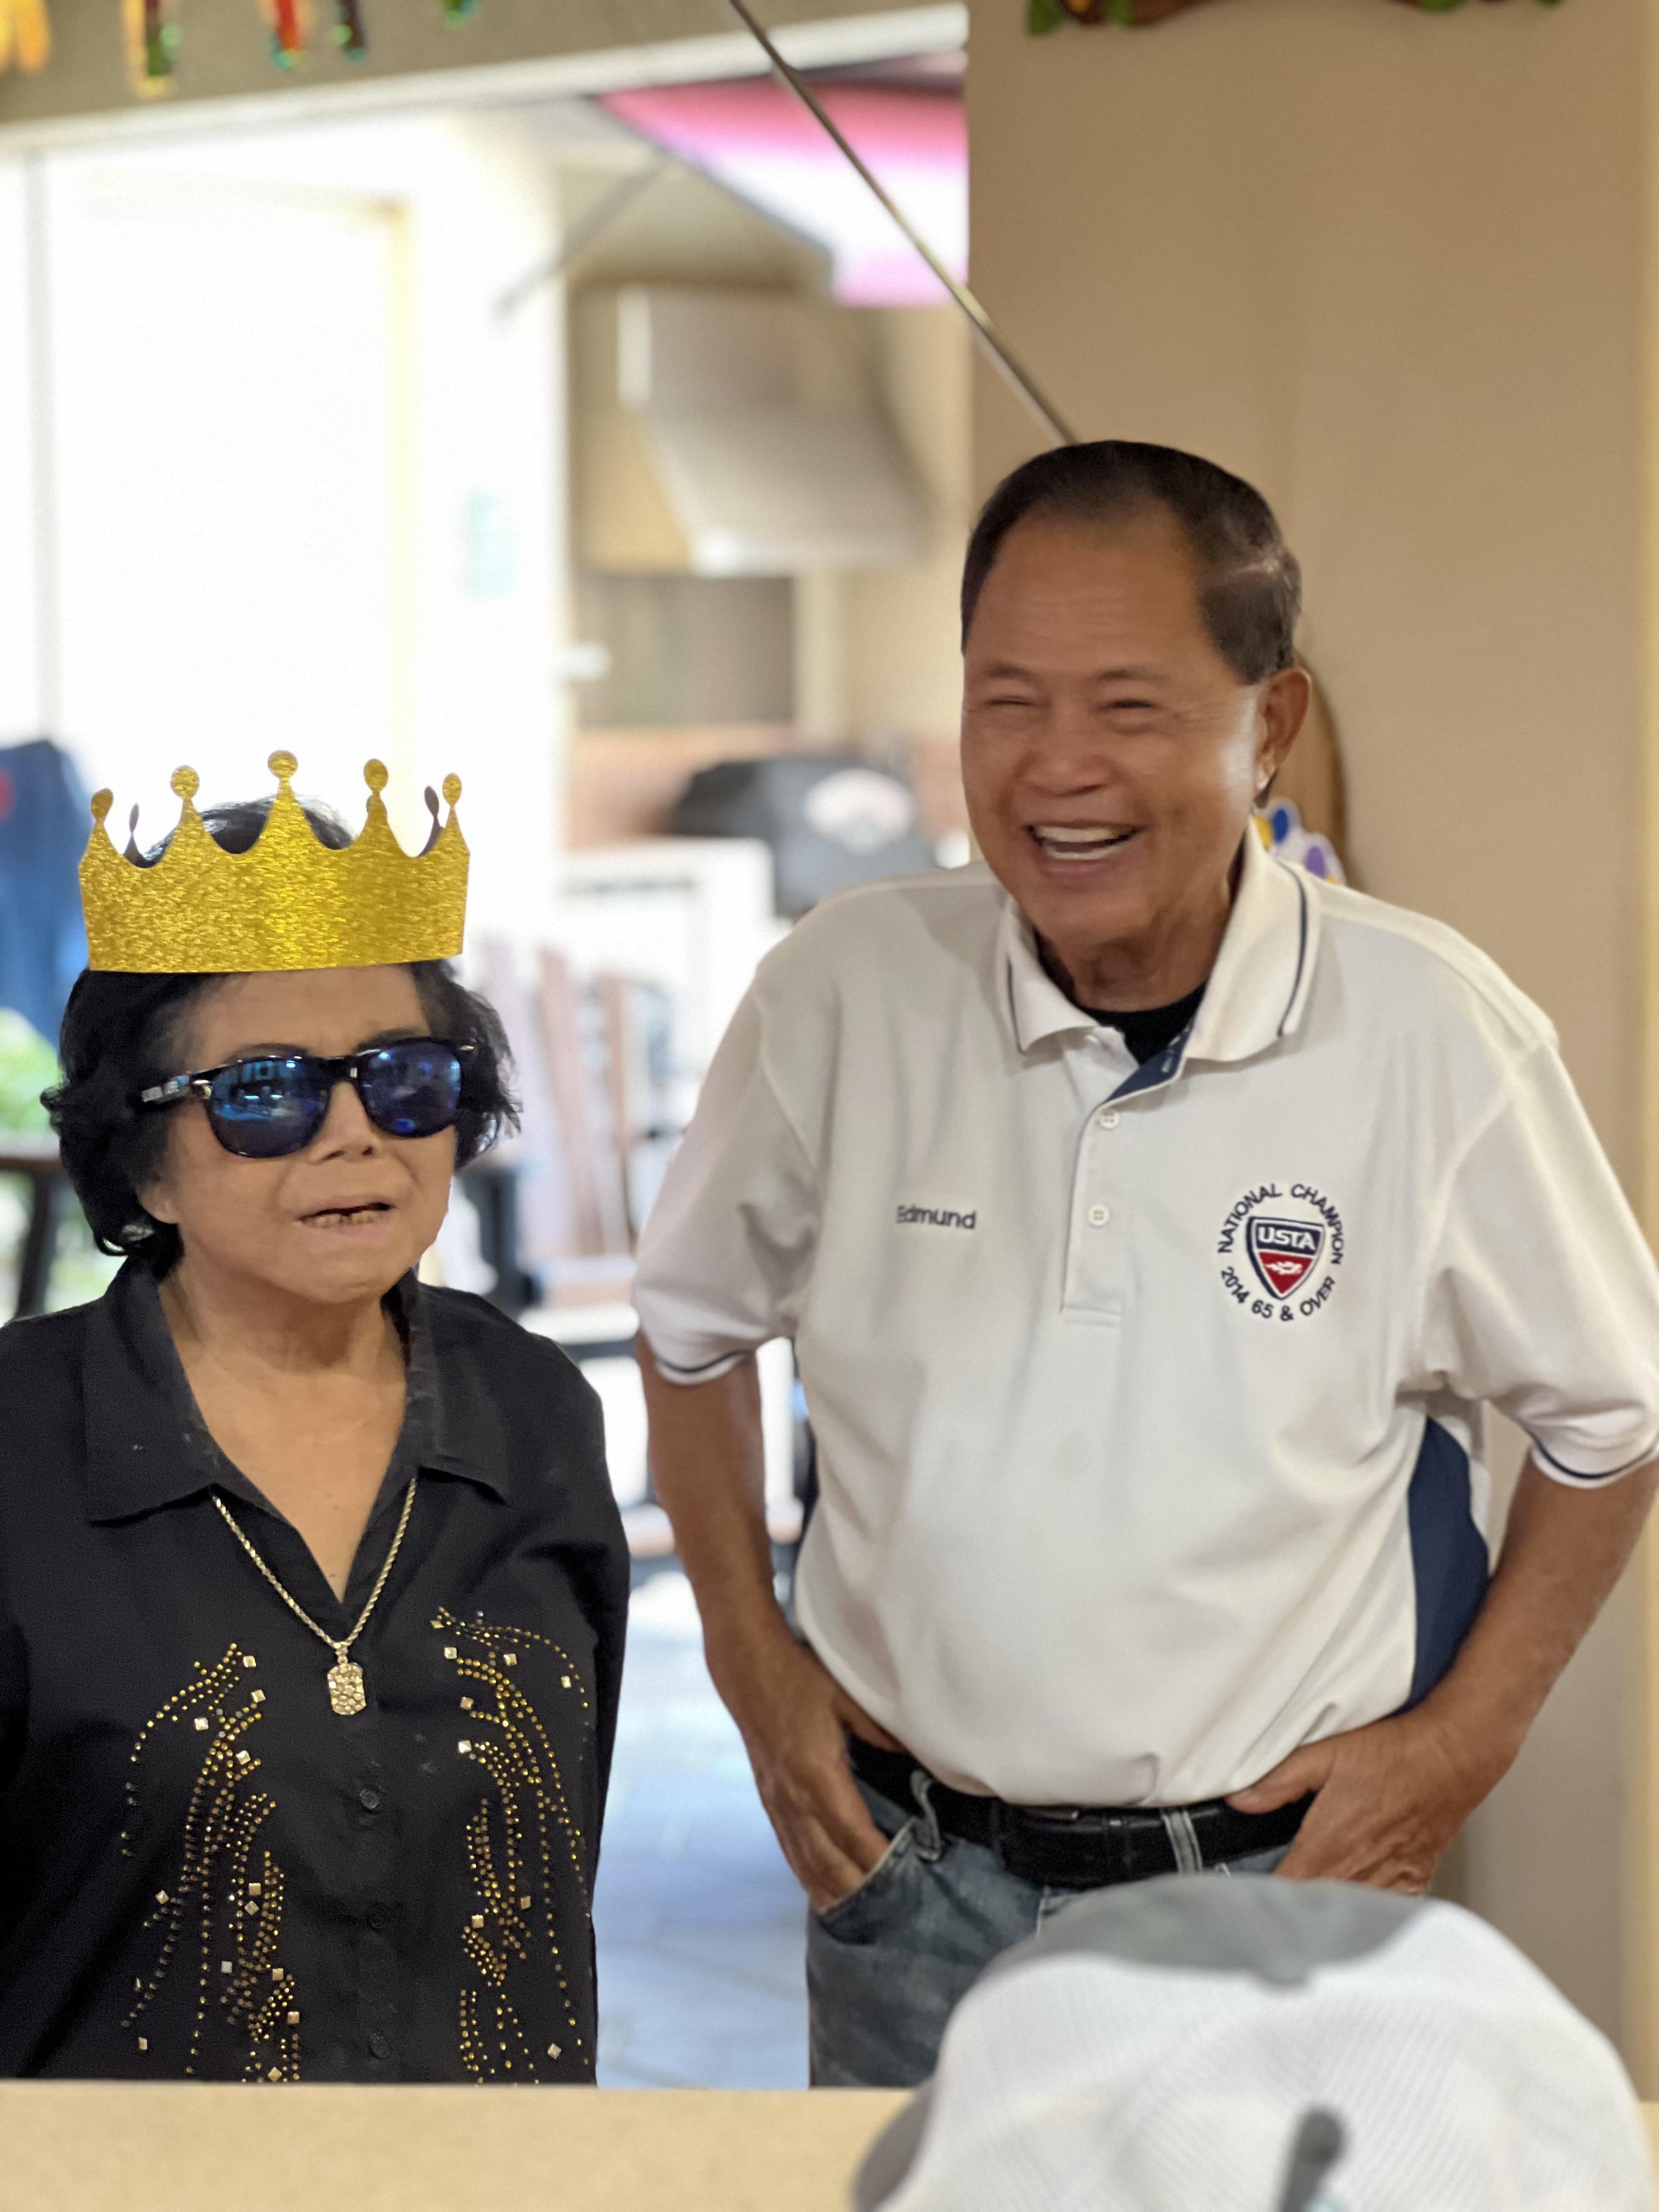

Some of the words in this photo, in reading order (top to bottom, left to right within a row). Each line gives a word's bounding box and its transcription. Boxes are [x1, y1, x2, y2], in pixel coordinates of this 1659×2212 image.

[897, 1204, 976, 1229] Edmund
[1217, 1183, 1283, 1254] NATIONAL
[1290, 1184, 1344, 1265] CHAMPION
[1258, 1227, 1316, 1251] USTA
[1221, 1267, 1250, 1304] 2014
[1251, 1300, 1274, 1319] 65
[1279, 1305, 1294, 1322] &
[1300, 1276, 1335, 1316] OVER
